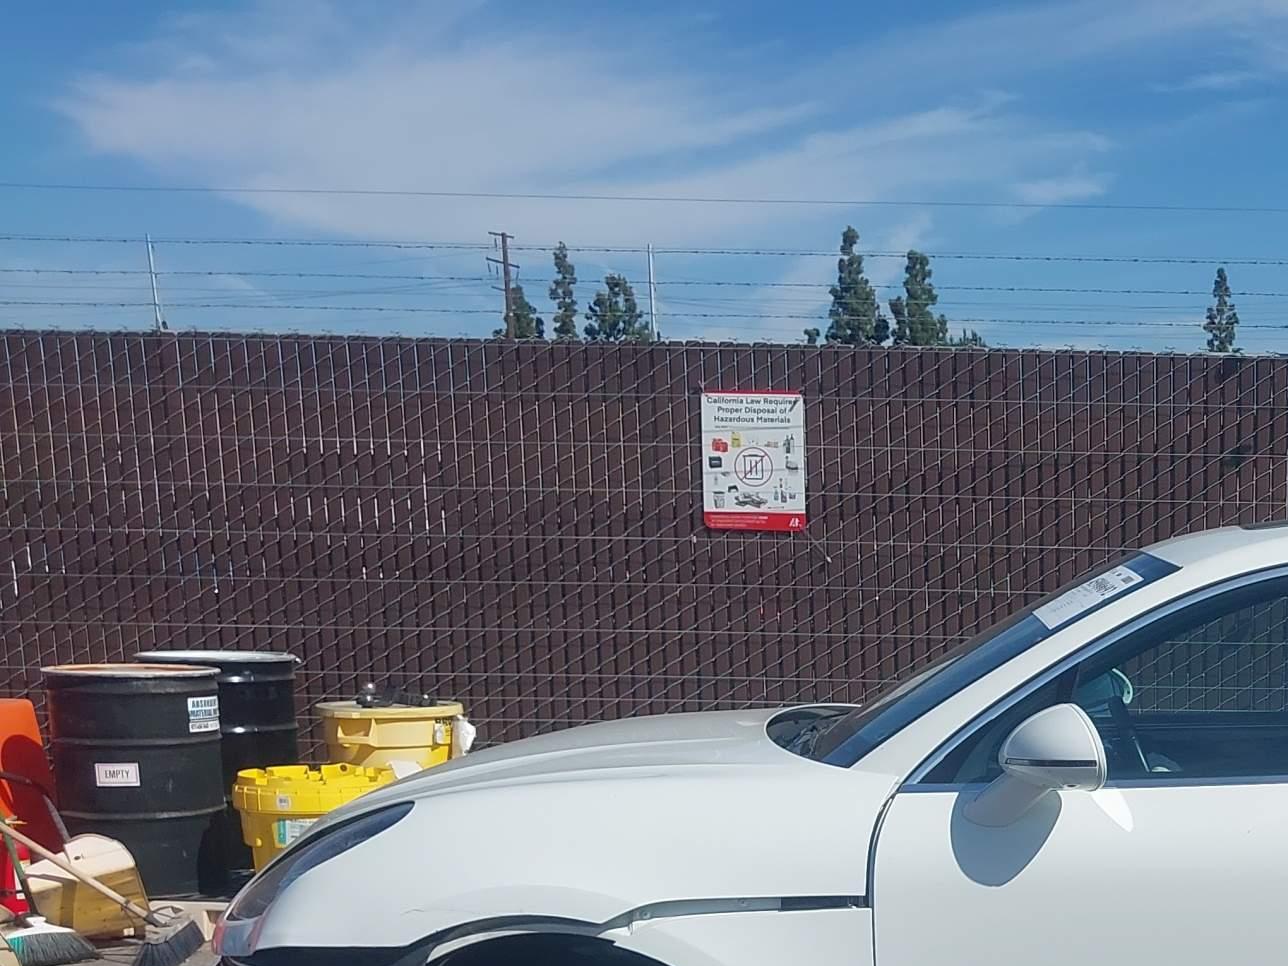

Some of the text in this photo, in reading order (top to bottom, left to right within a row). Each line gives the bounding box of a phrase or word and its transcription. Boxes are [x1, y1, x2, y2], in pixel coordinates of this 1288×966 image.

[717, 406, 743, 415] Proper
[744, 407, 777, 415] Disposal
[756, 416, 791, 424] Materials
[104, 769, 130, 779] EMPTY
